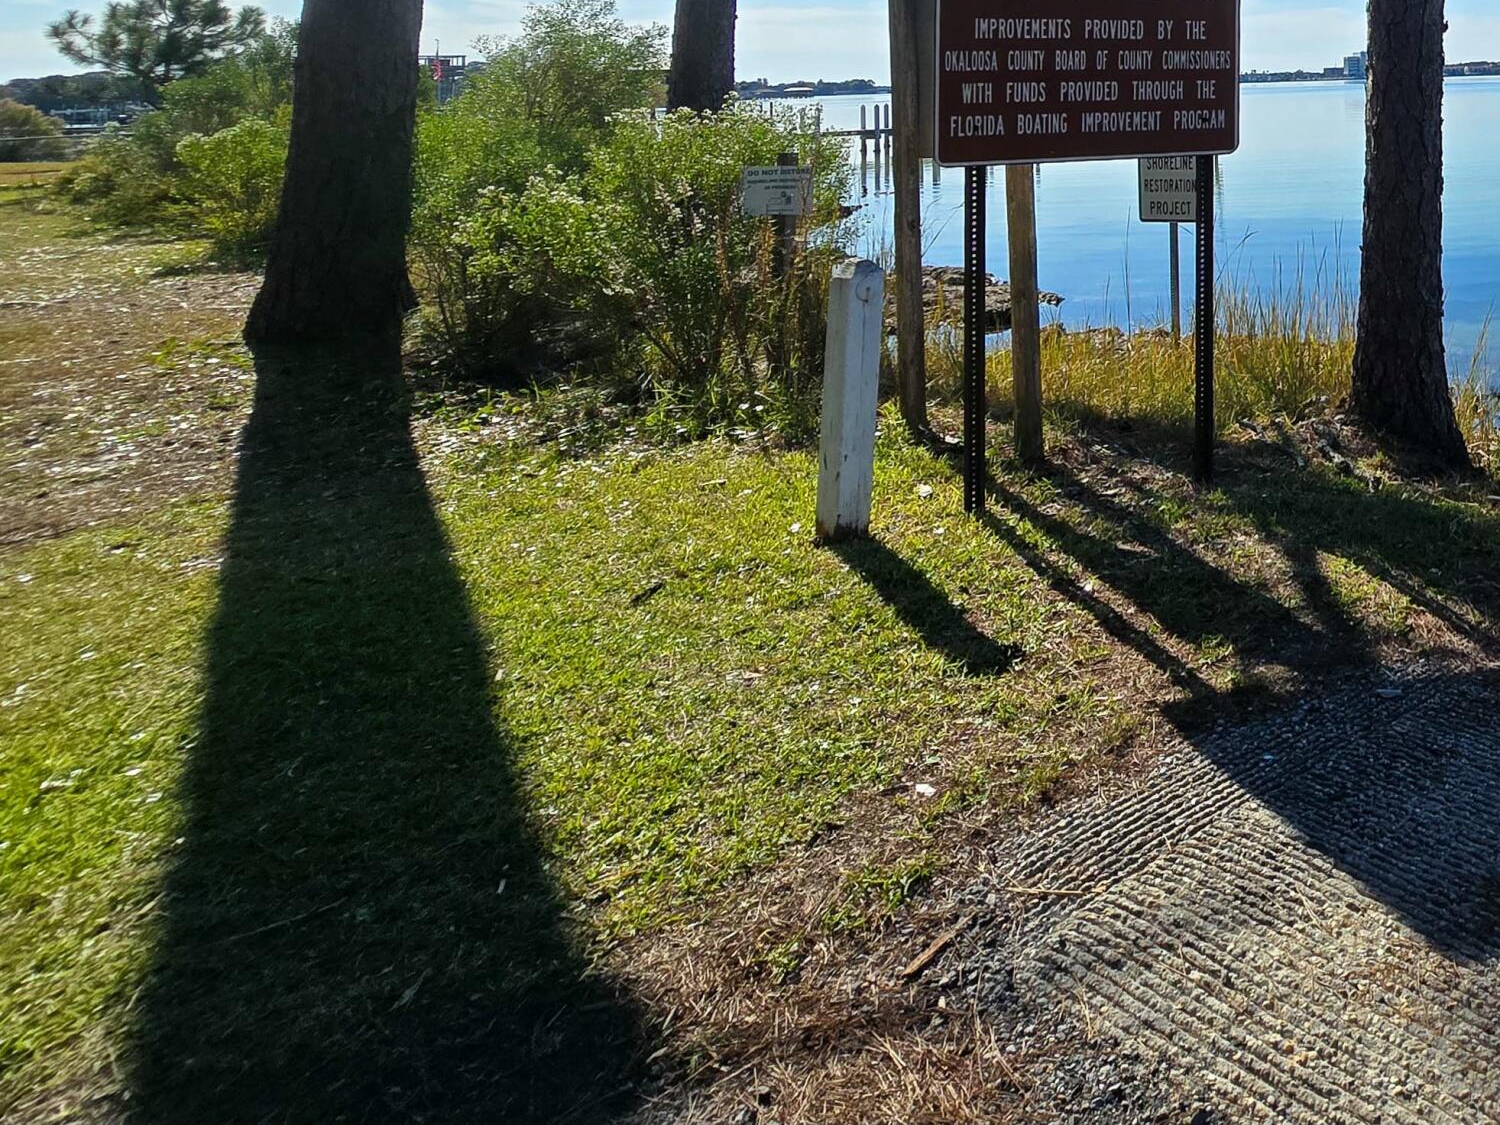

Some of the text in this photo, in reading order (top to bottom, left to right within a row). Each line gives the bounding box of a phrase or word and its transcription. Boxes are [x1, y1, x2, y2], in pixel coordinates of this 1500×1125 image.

[974, 17, 1206, 40] IMPROVEMENTS PROVIDED BY THE
[944, 49, 1231, 72] OKALOOSA COUNTY BOARD OF COUNTY COMMISSIONERS
[962, 80, 1216, 104] WITH FUNDS PROVIDED THROUGH THE
[950, 109, 1226, 137] FLORIDA BOATING IMPROVEMENT PROGRAM
[1146, 156, 1194, 171] SHORELINE
[1144, 178, 1197, 193] RESTORATION
[1149, 201, 1192, 215] PROJECT
